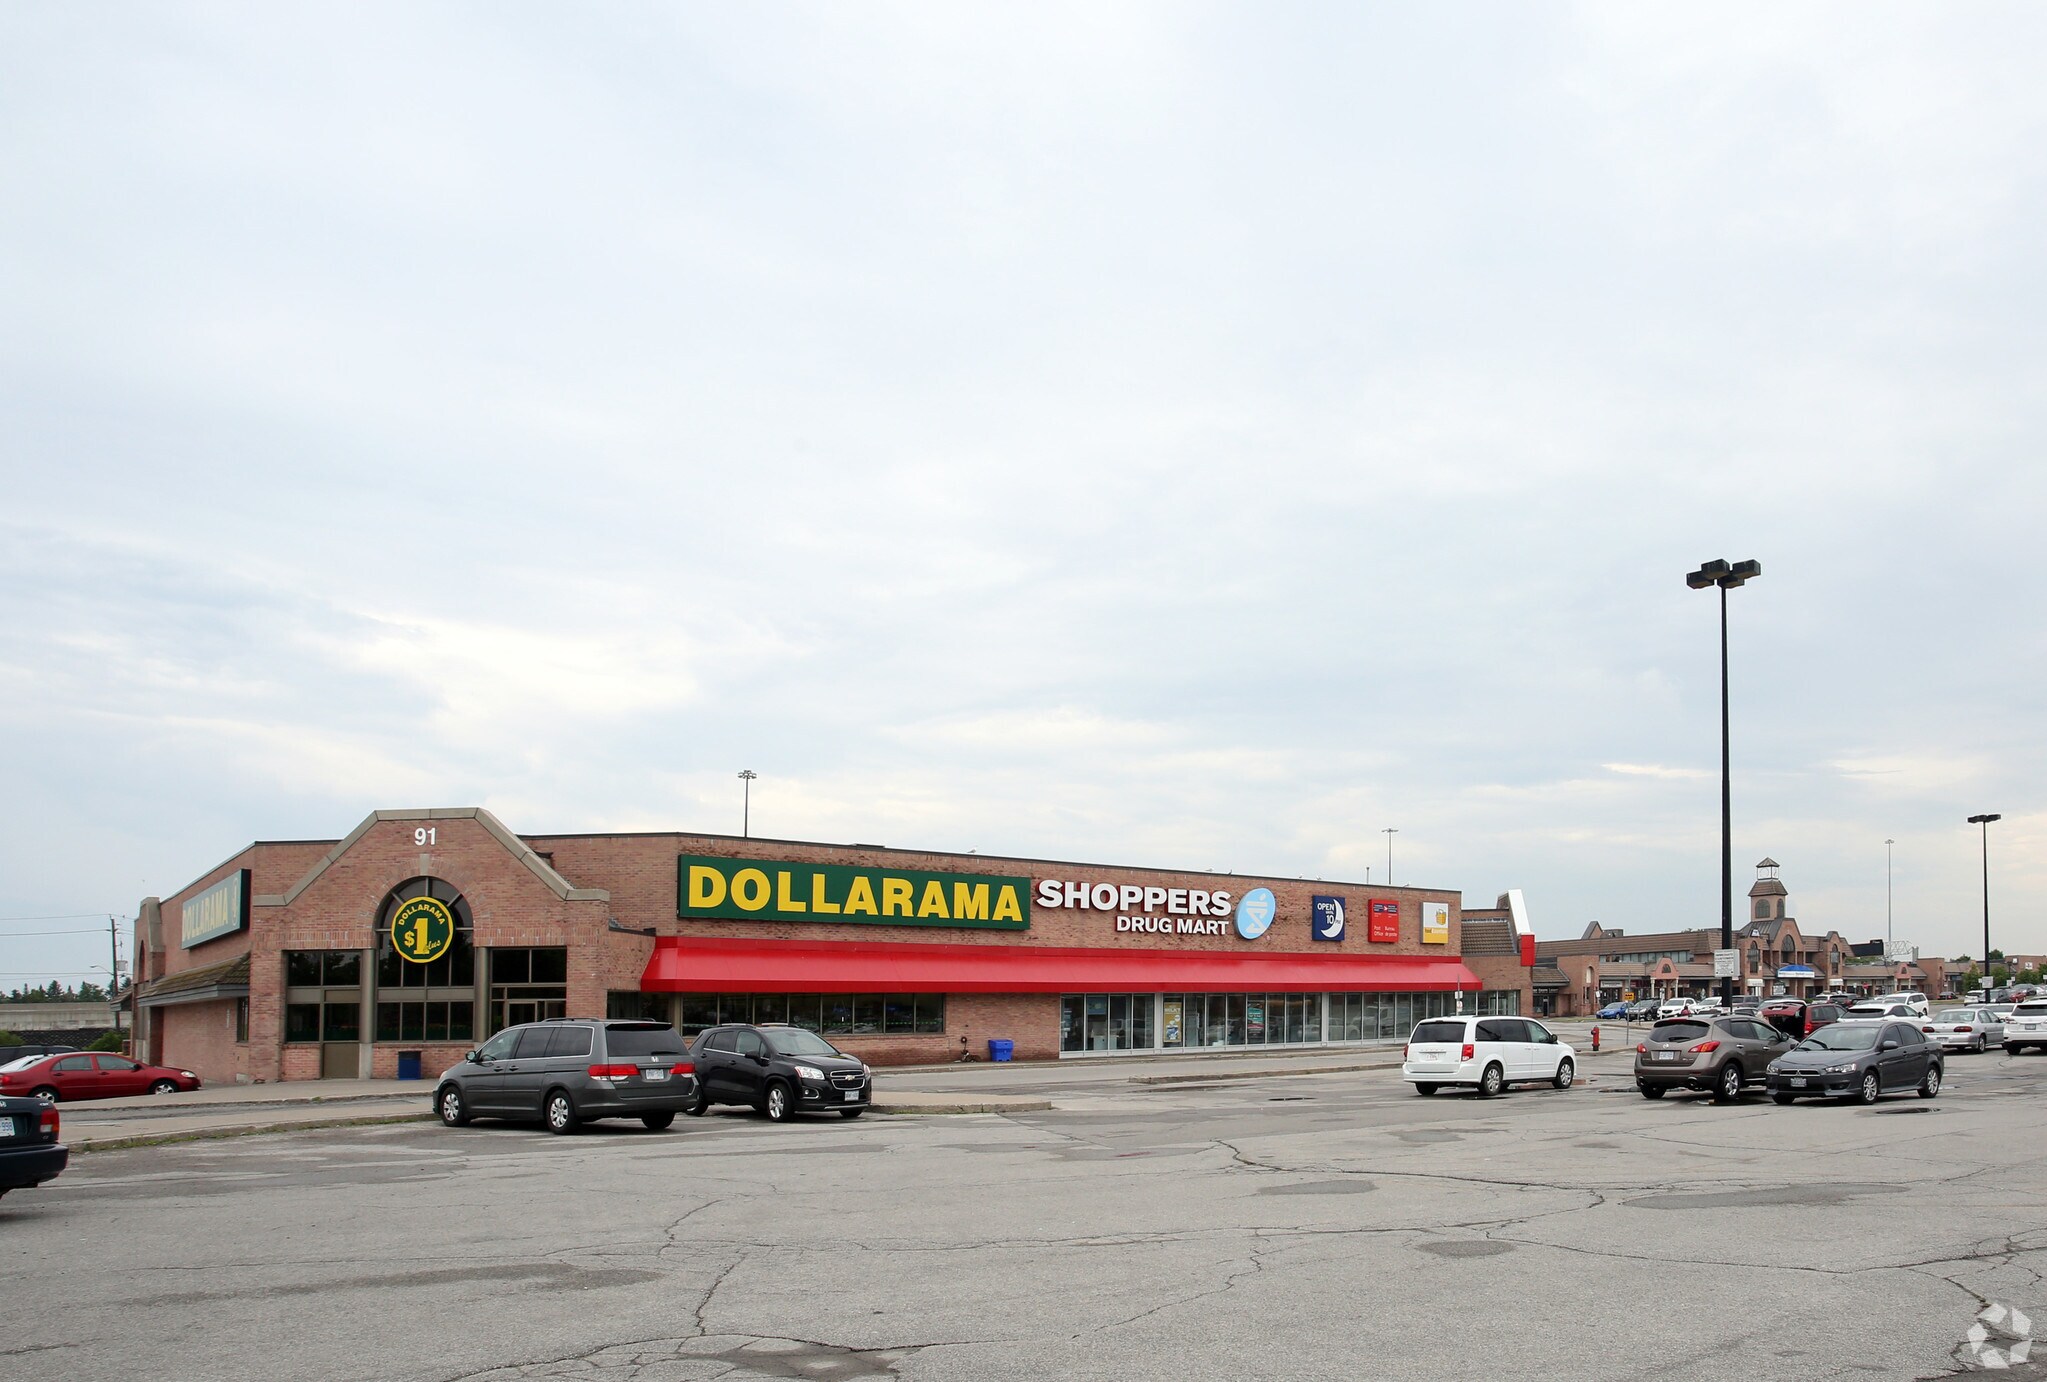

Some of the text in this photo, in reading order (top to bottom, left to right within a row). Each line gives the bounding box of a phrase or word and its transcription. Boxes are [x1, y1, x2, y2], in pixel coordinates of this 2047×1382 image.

[414, 827, 436, 845] 91
[687, 865, 1023, 922] DOLLARAMA
[1036, 879, 1231, 916] SHOPPERS
[182, 887, 229, 942] DOLLARAMA
[398, 904, 445, 926] DOLLARAMA
[1317, 902, 1335, 911] OPEN
[1116, 915, 1230, 935] DRUG MART
[1326, 914, 1335, 924] 10
